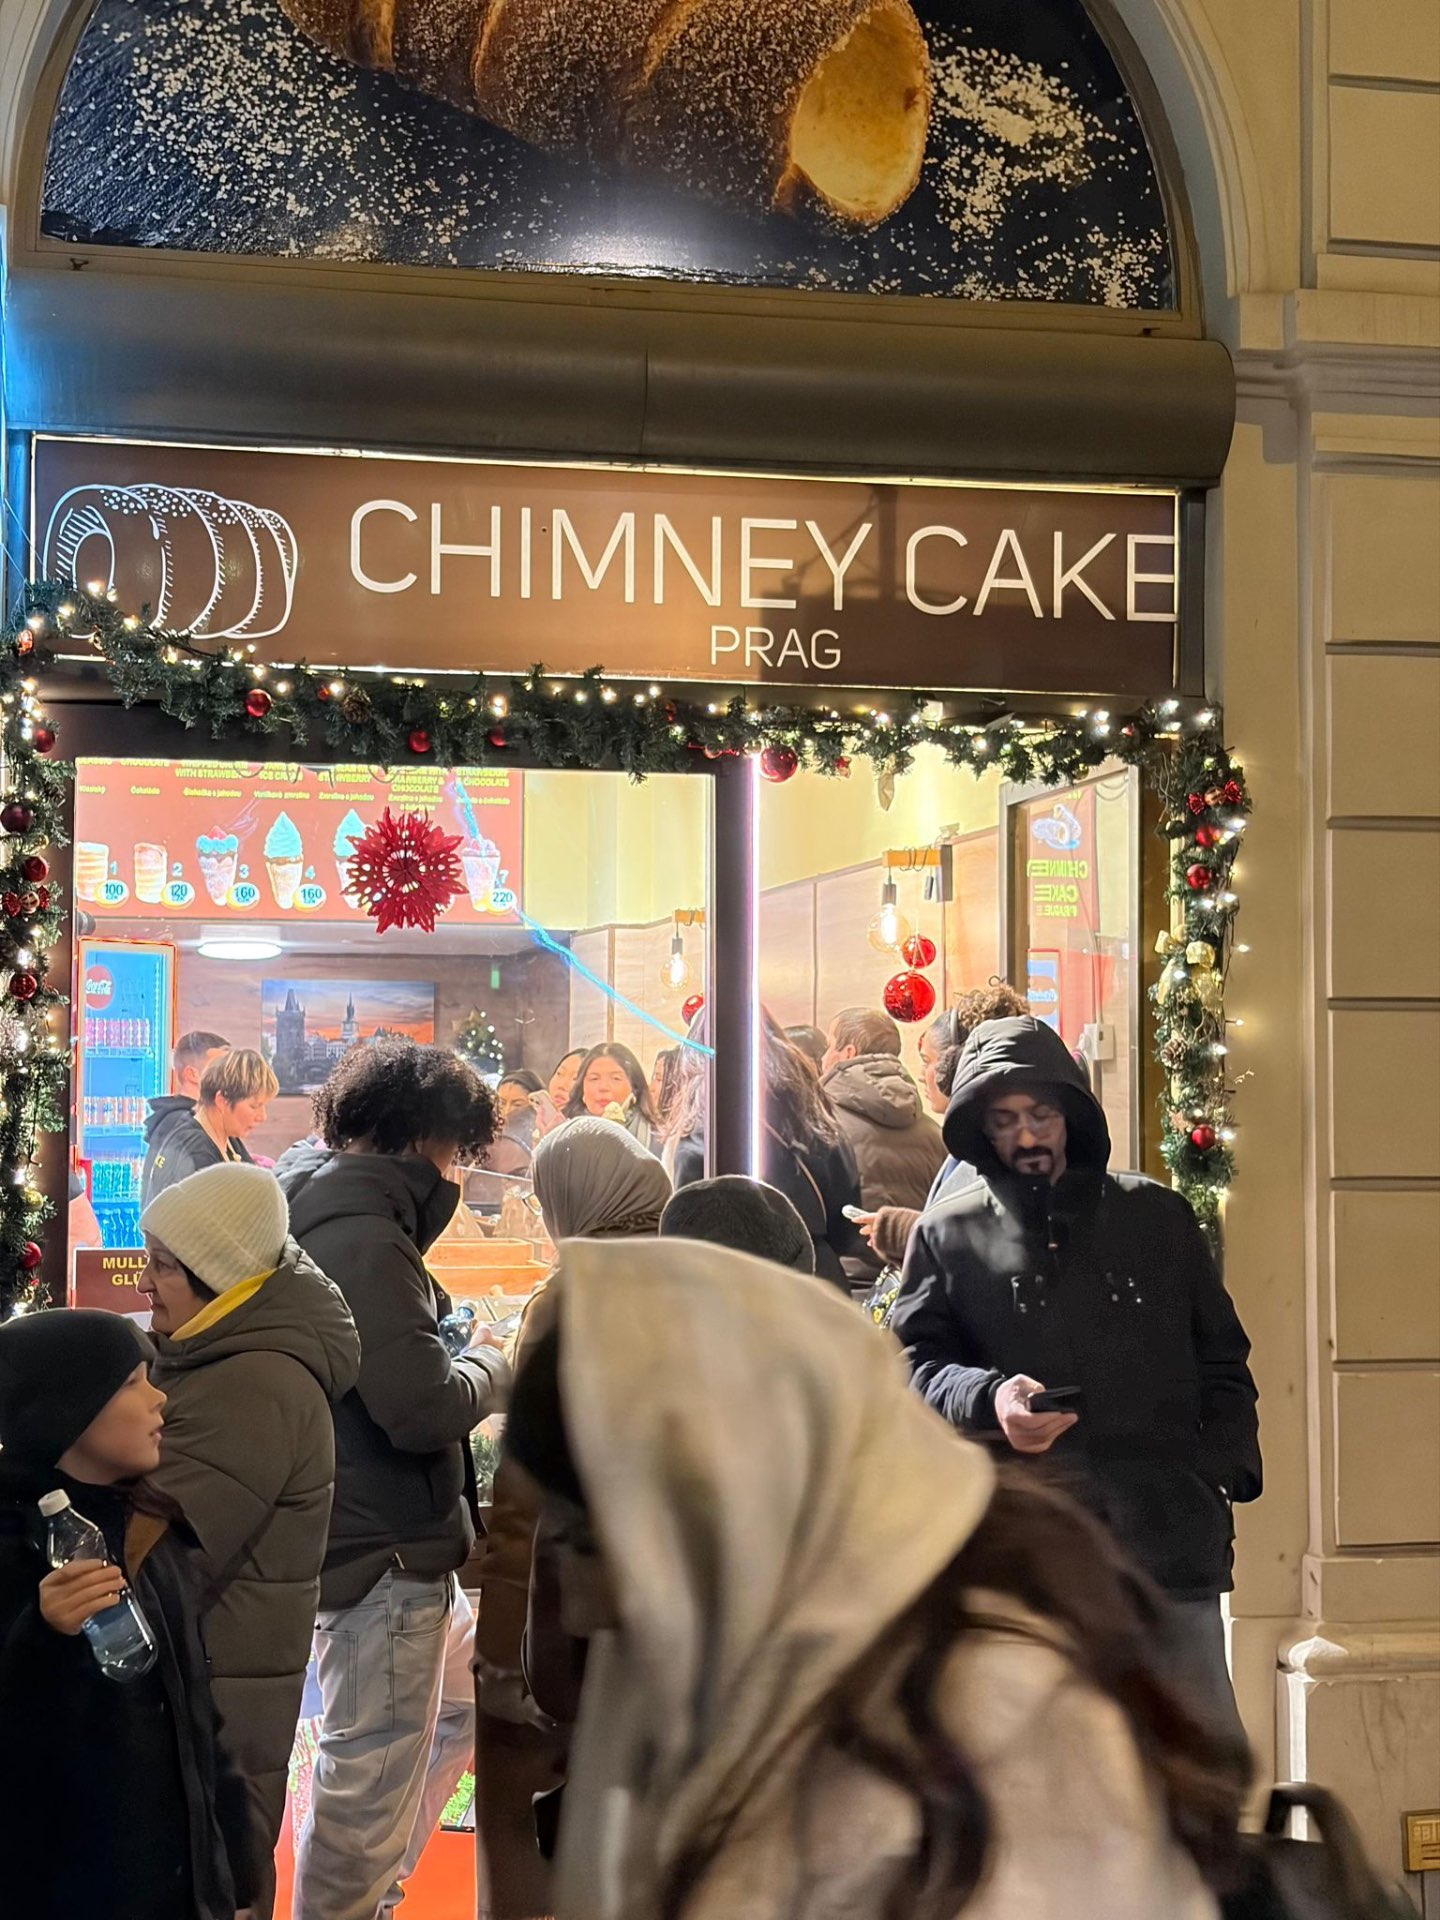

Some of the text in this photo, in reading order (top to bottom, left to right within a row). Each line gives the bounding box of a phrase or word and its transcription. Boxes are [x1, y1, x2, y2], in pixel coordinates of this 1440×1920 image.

[350, 499, 1178, 623] CHIMNEY CAKE
[710, 625, 842, 670] PRAG
[239, 864, 249, 878] 3
[105, 884, 124, 896] 100
[171, 884, 188, 896] 120
[234, 886, 255, 898] 160
[301, 888, 322, 900] 160
[492, 892, 513, 903] 220
